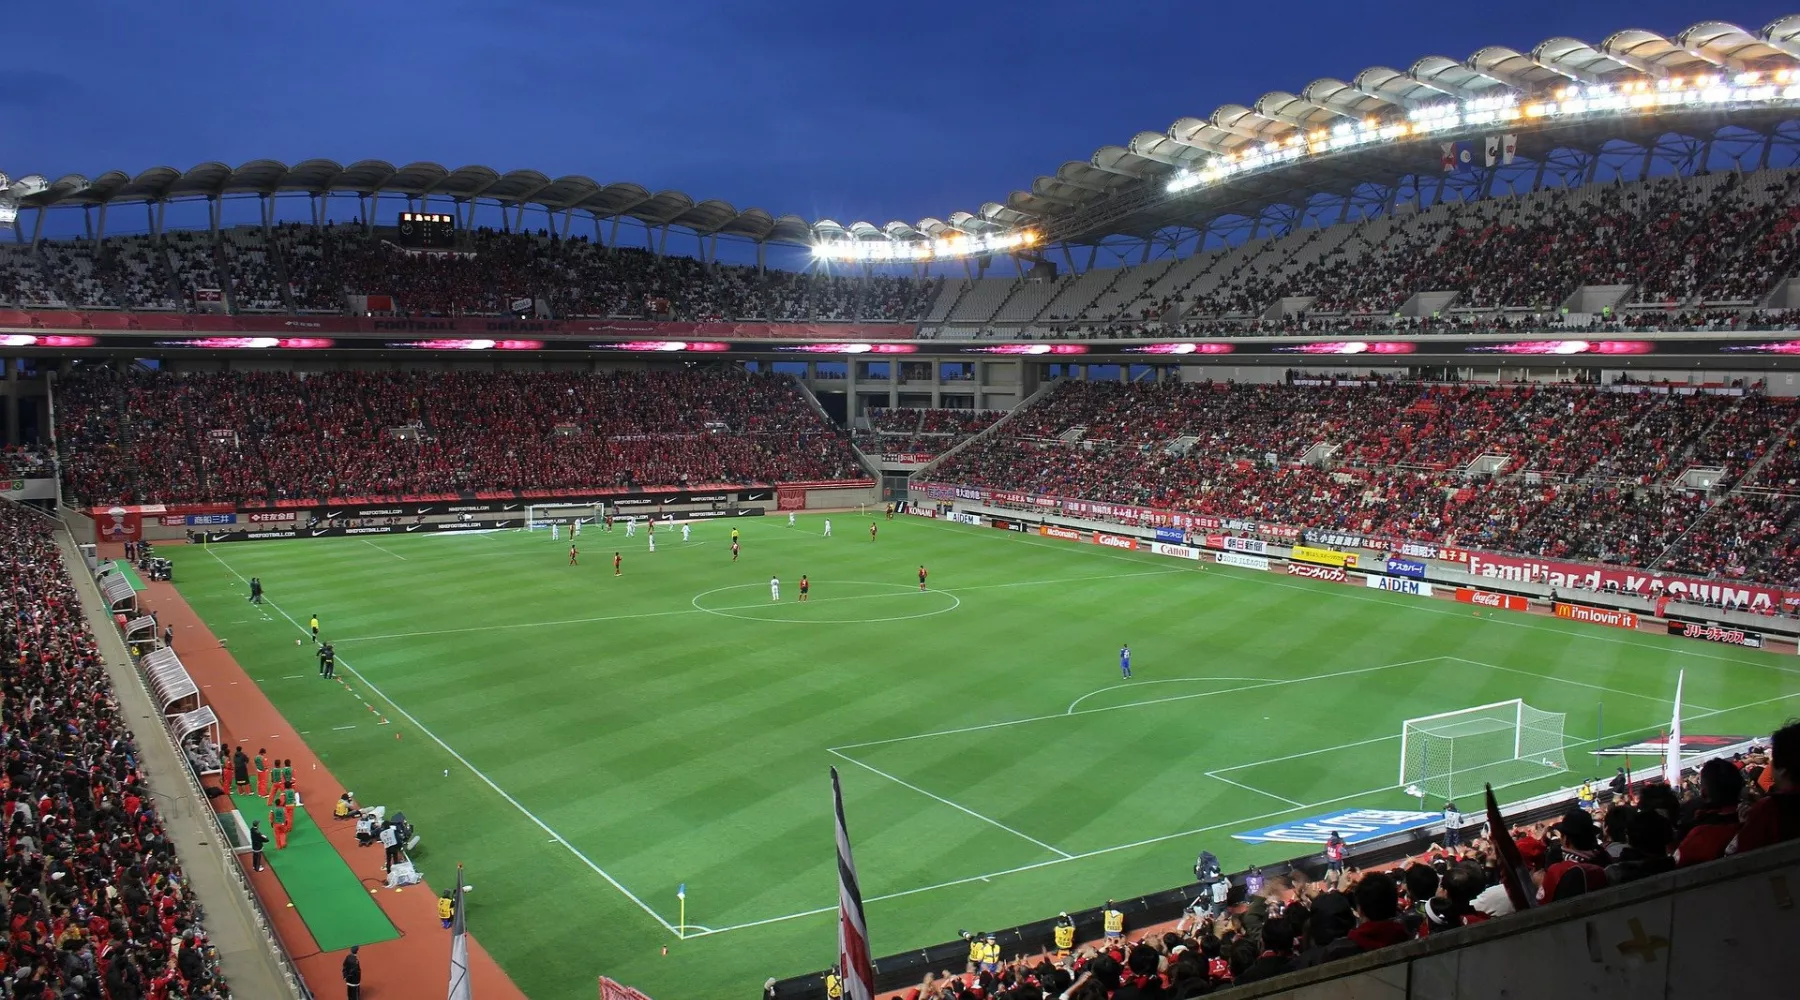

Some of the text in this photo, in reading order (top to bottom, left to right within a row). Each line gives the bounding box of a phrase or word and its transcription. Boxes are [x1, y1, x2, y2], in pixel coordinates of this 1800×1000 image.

[194, 514, 230, 525] 商船三井
[909, 507, 933, 518] KONAMI
[1047, 527, 1078, 540] McDonald's
[1099, 534, 1131, 549] Calbee
[1227, 538, 1264, 552] 朝日新聞
[1160, 544, 1190, 558] Canon
[1626, 575, 1772, 610] KASHIMA
[1571, 606, 1632, 627] i'm lovin' it
[1683, 623, 1745, 645] Jリーグチップス
